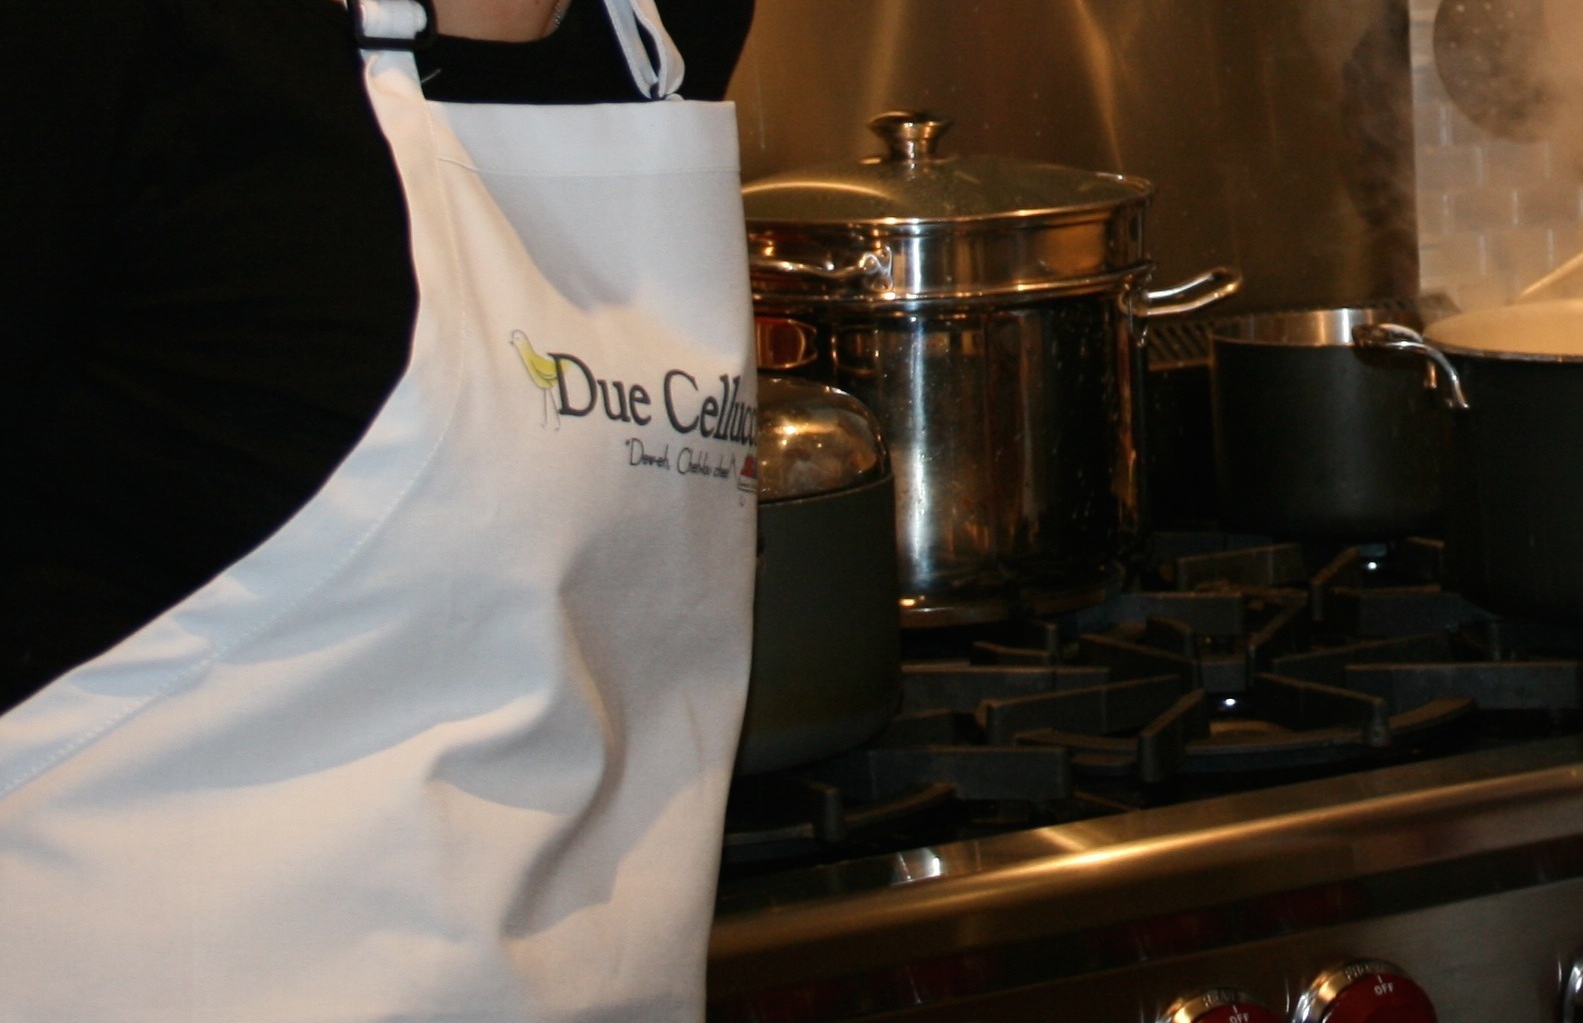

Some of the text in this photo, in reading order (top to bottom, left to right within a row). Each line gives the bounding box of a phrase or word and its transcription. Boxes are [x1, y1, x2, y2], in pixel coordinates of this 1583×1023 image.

[547, 352, 651, 426] Due
[1373, 981, 1395, 996] OFF
[1229, 1012, 1250, 1023] OFF
